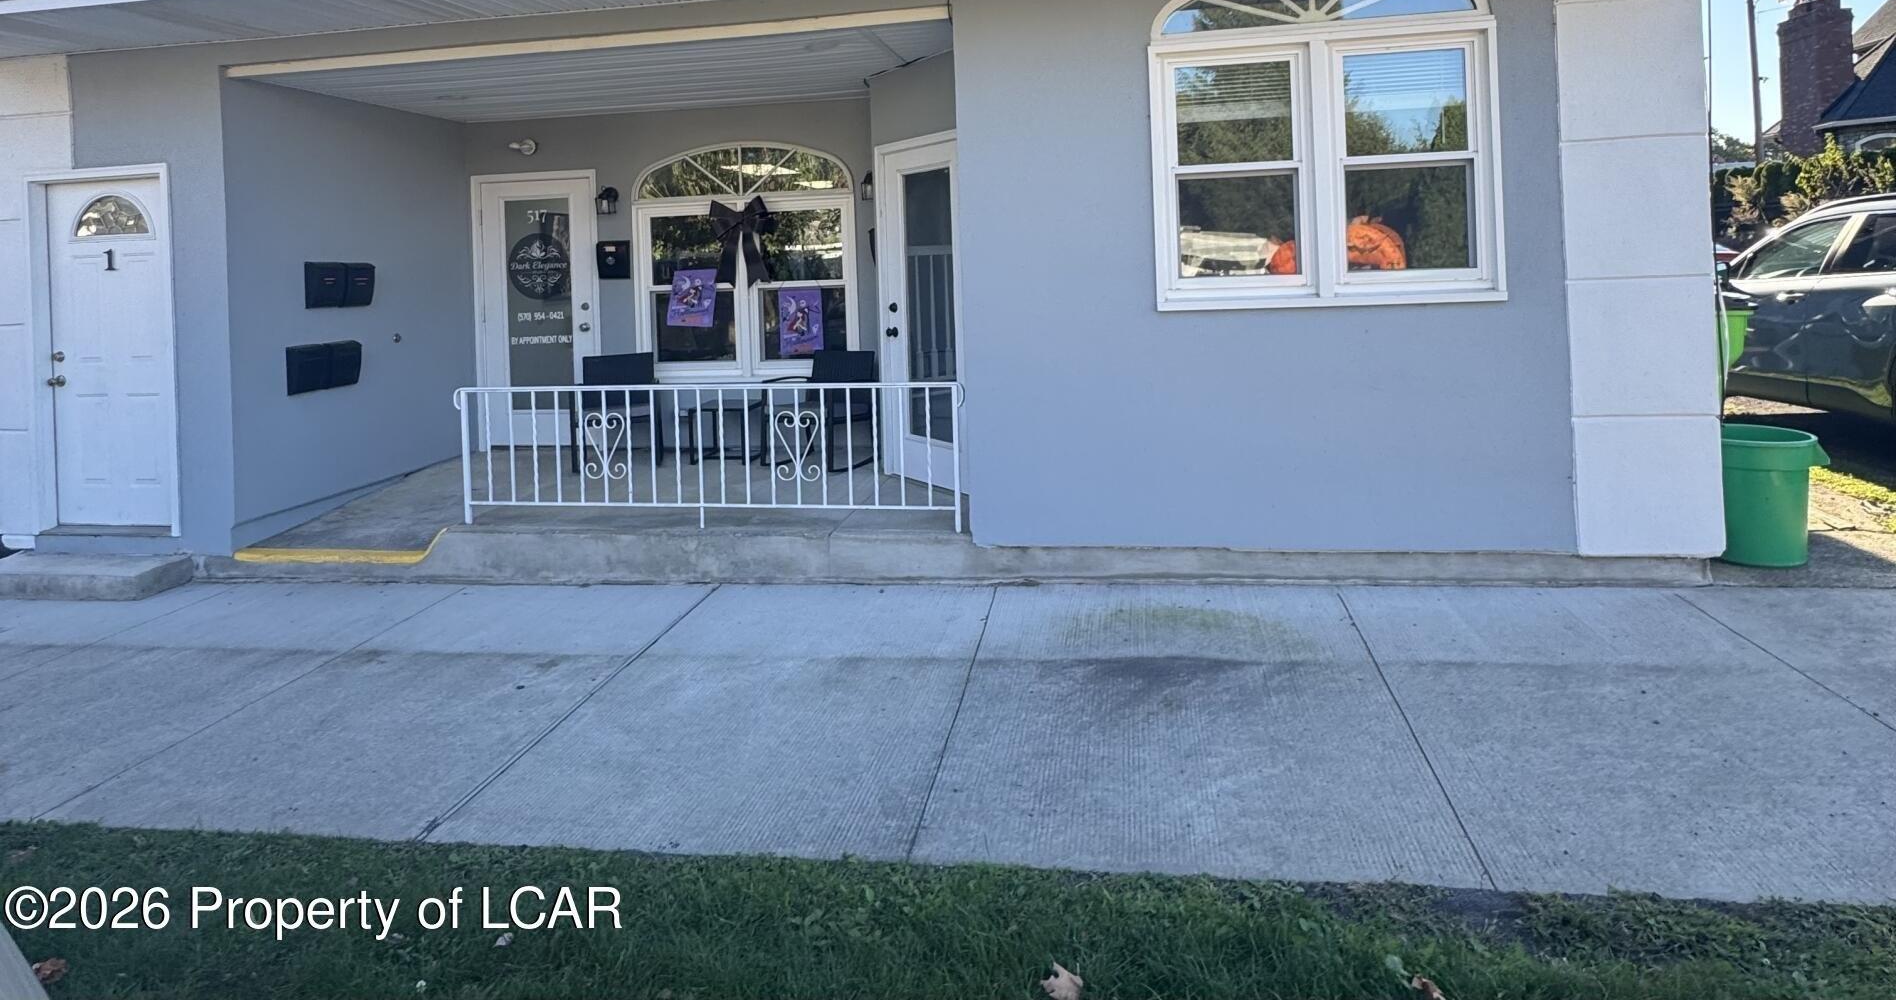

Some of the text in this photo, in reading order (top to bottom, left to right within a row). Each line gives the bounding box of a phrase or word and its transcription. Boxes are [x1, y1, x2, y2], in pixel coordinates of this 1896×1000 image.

[527, 209, 548, 224] 517
[102, 248, 118, 271] 1
[510, 261, 568, 272] Dark Elegance
[518, 312, 532, 322] (570)
[511, 335, 573, 345] BY APPOINTMENT ONLY
